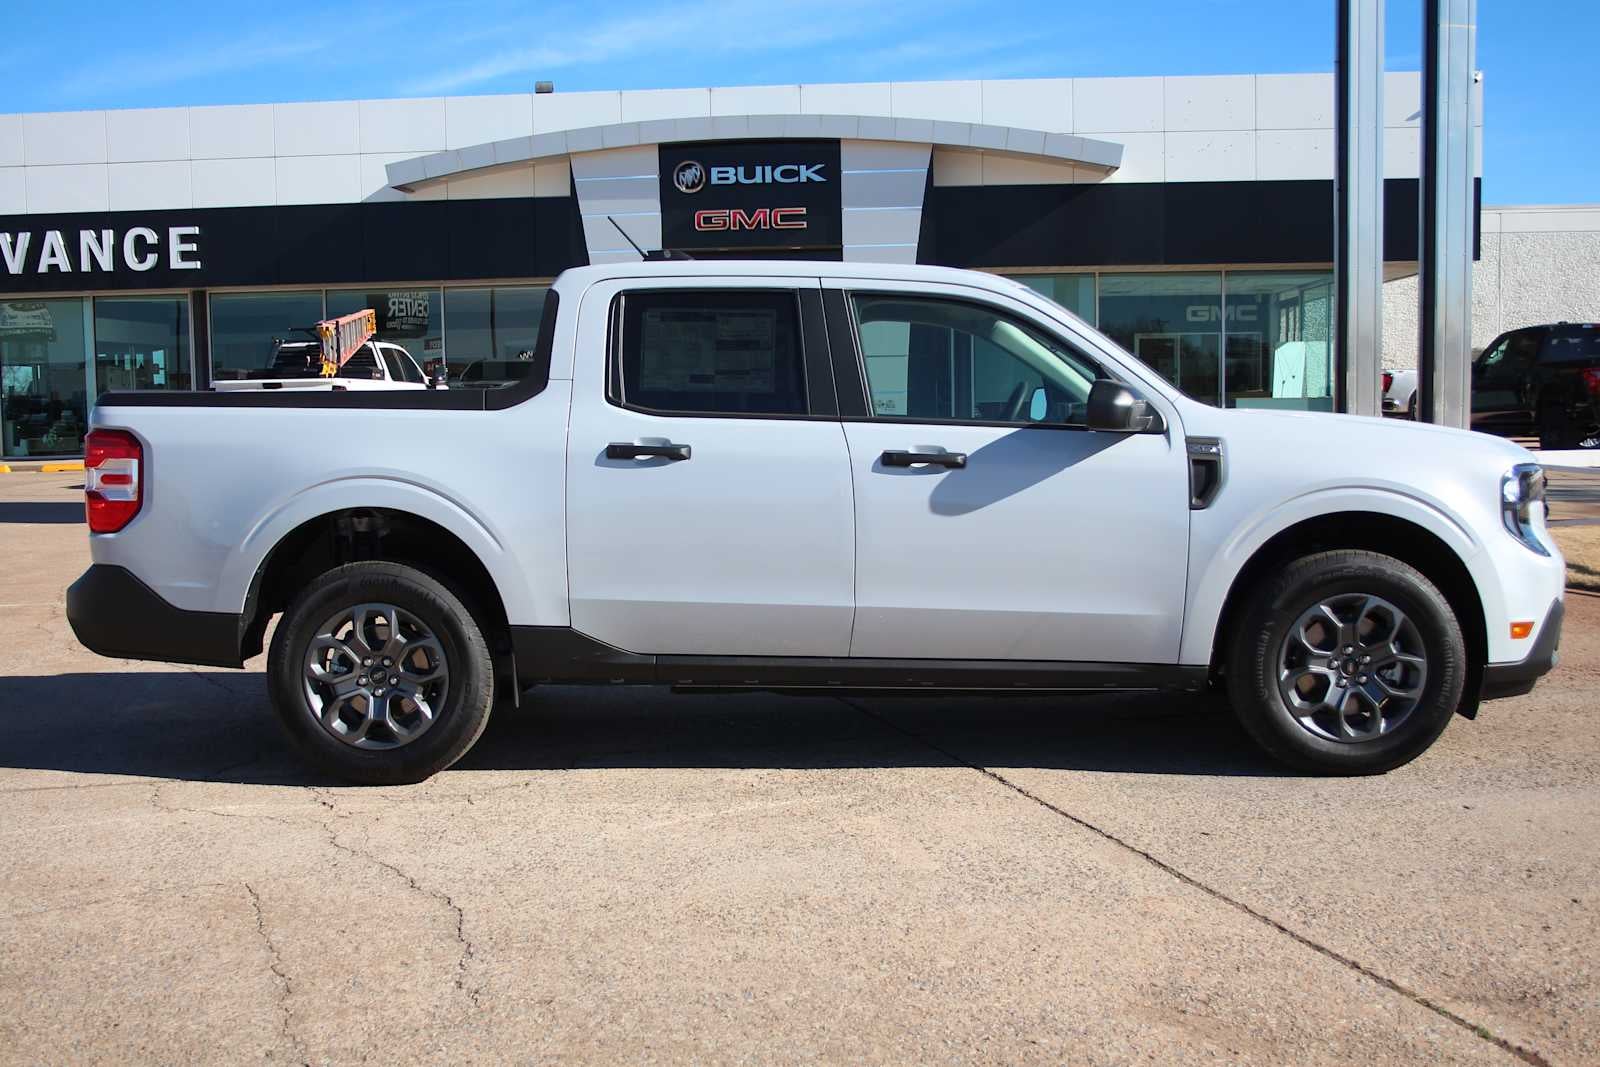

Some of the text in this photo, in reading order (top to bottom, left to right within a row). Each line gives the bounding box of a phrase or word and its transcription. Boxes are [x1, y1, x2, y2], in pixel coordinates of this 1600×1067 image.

[711, 164, 826, 186] BUICK
[695, 208, 808, 232] GMC
[0, 226, 202, 274] VANCE
[1186, 305, 1257, 322] GMC
